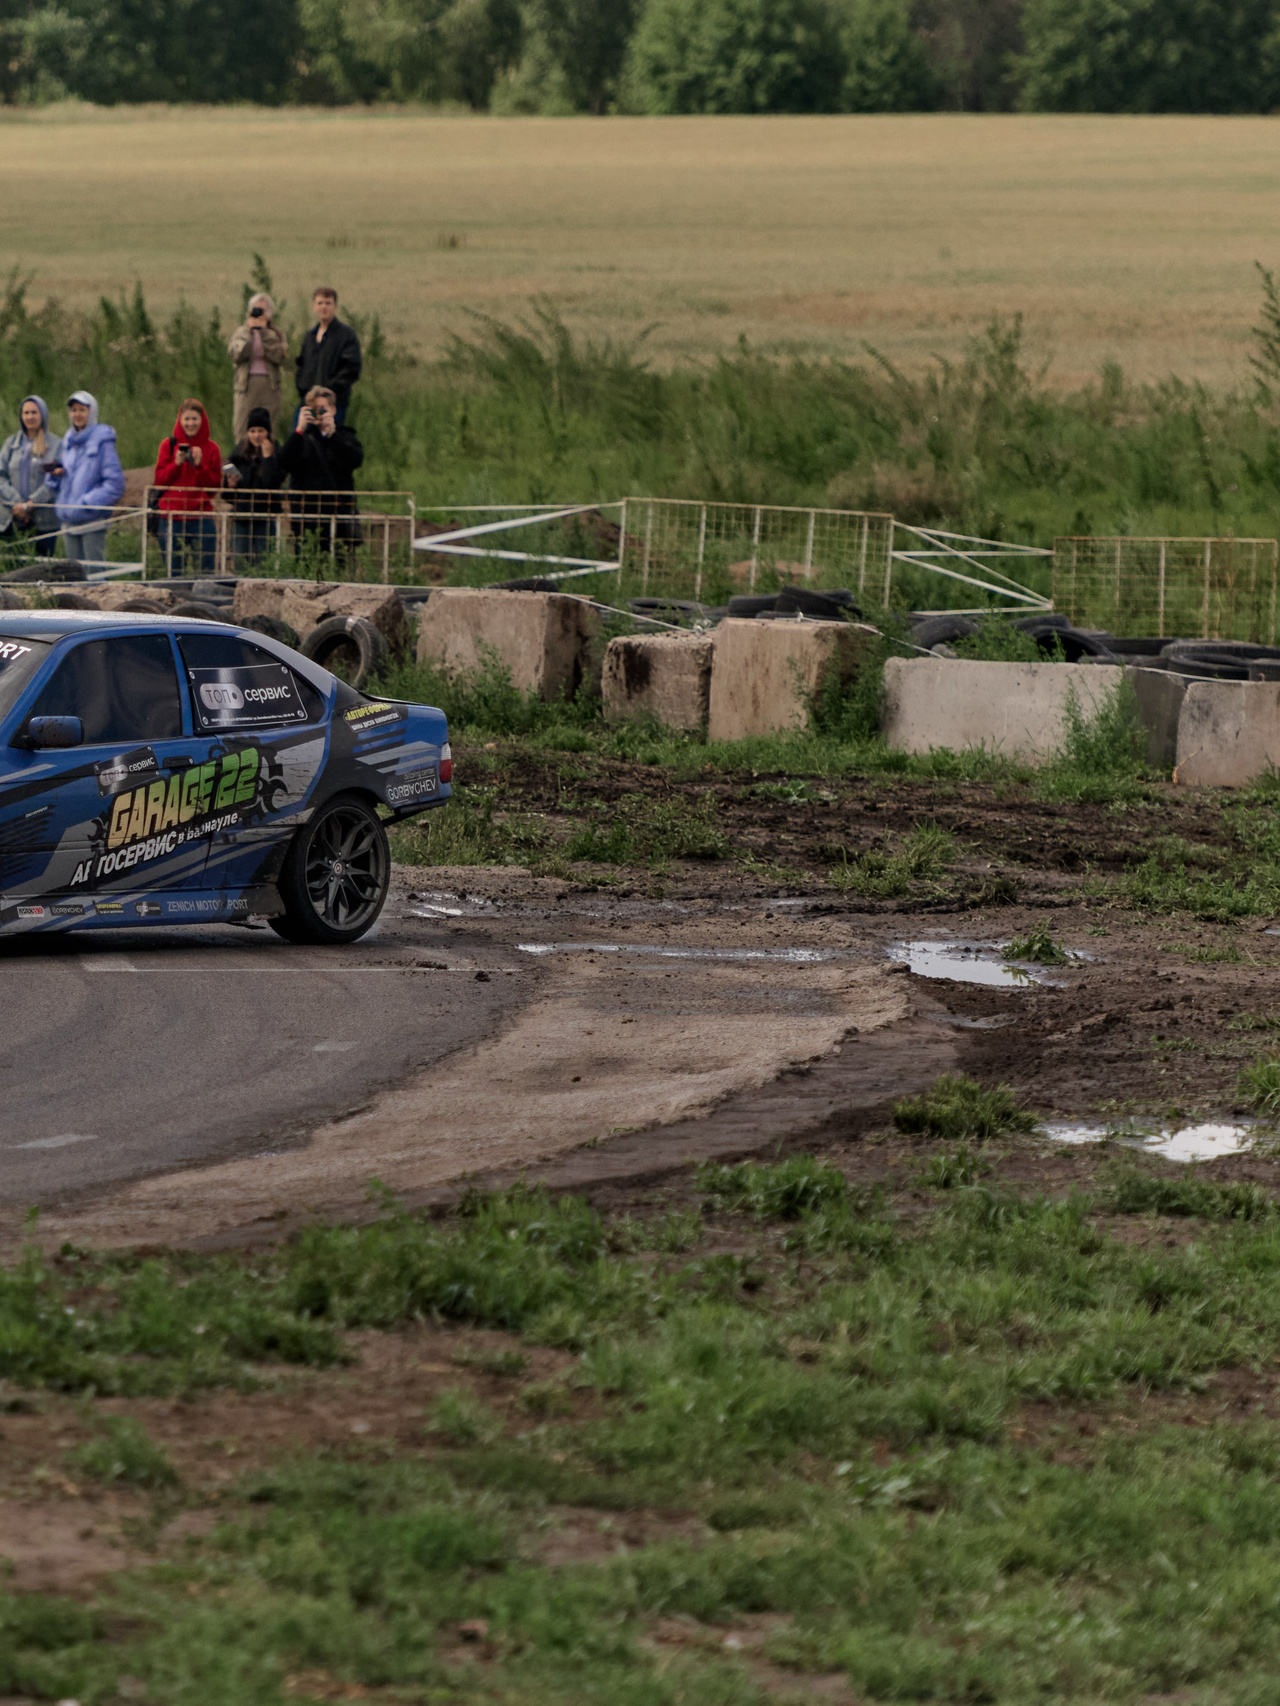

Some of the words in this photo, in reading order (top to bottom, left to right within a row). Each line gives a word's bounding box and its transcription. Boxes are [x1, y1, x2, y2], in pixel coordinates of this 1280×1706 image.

[244, 685, 291, 703] сервис
[128, 757, 155, 773] сервис
[107, 760, 217, 850] GARAGE
[215, 747, 259, 810] 22
[177, 832, 185, 845] в
[166, 900, 195, 912] ZENICH
